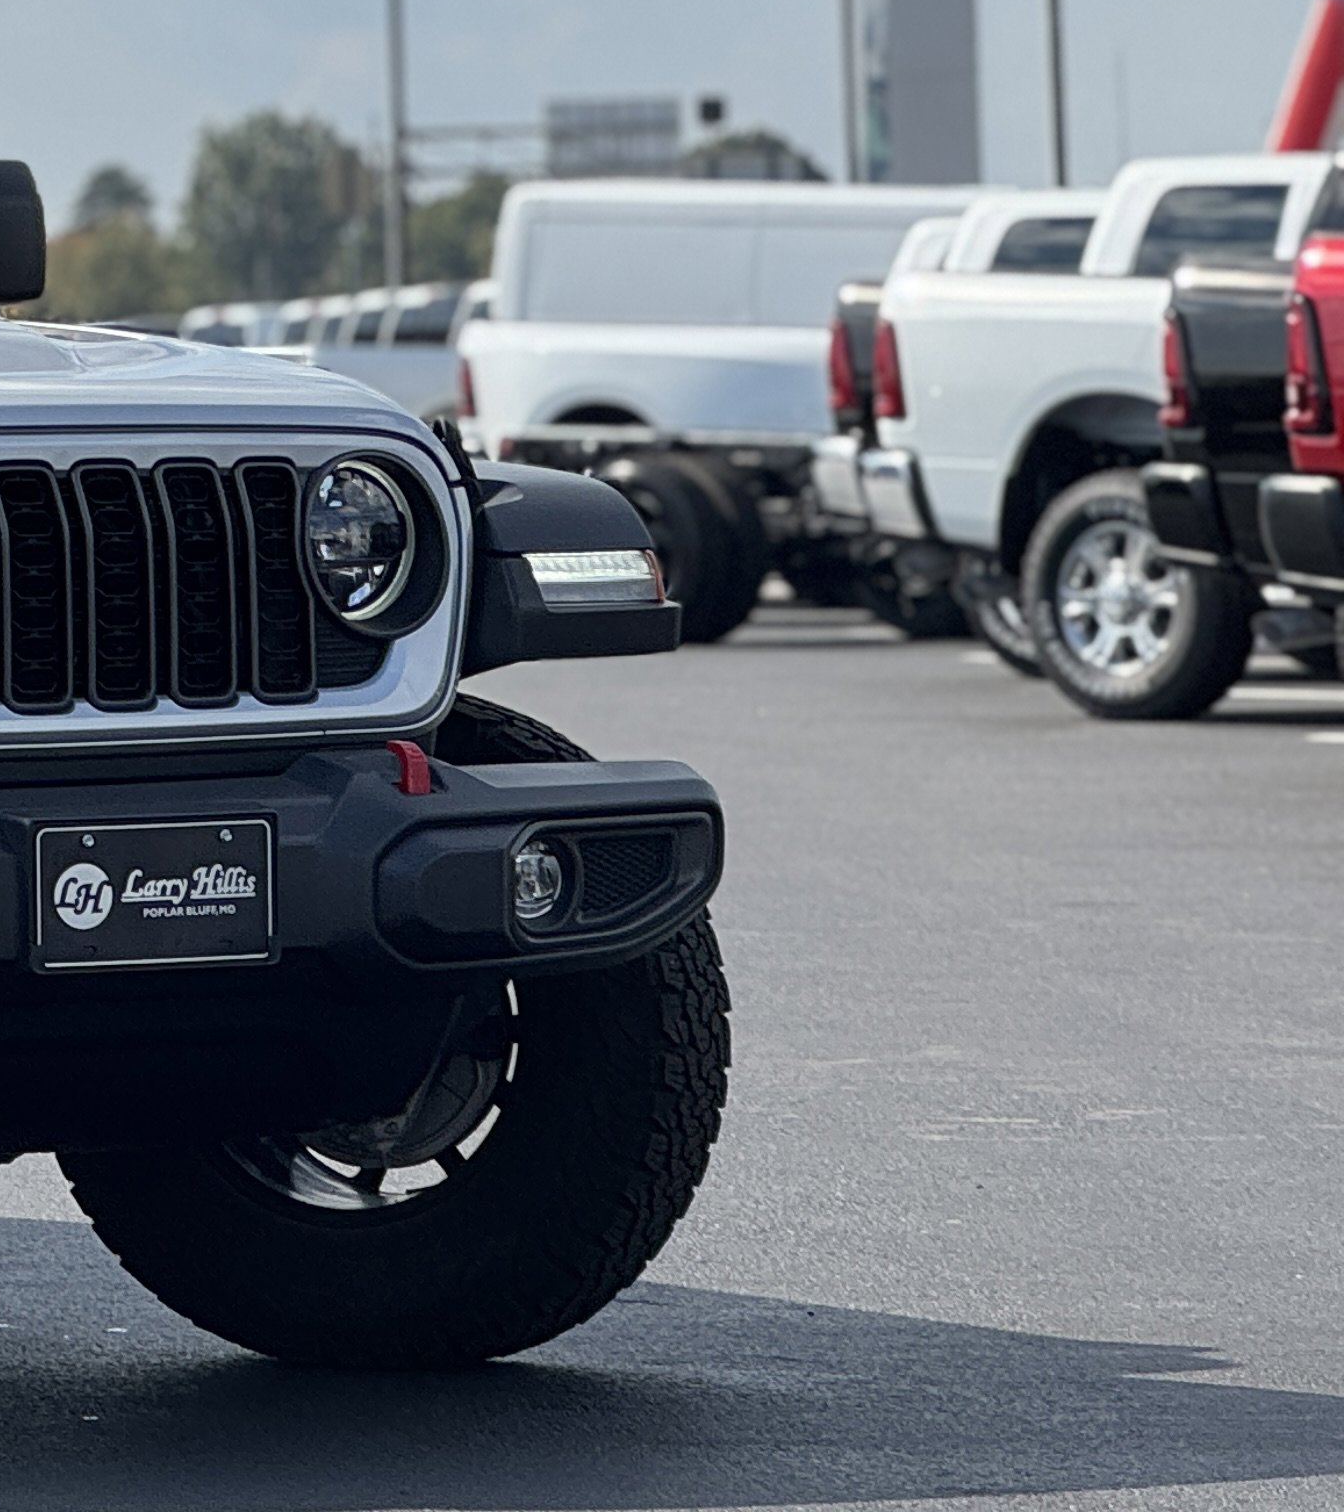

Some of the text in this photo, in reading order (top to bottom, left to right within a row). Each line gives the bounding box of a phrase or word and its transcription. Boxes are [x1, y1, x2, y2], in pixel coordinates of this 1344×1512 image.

[120, 863, 257, 905] Larry Hillis
[142, 905, 185, 919] POPLAR
